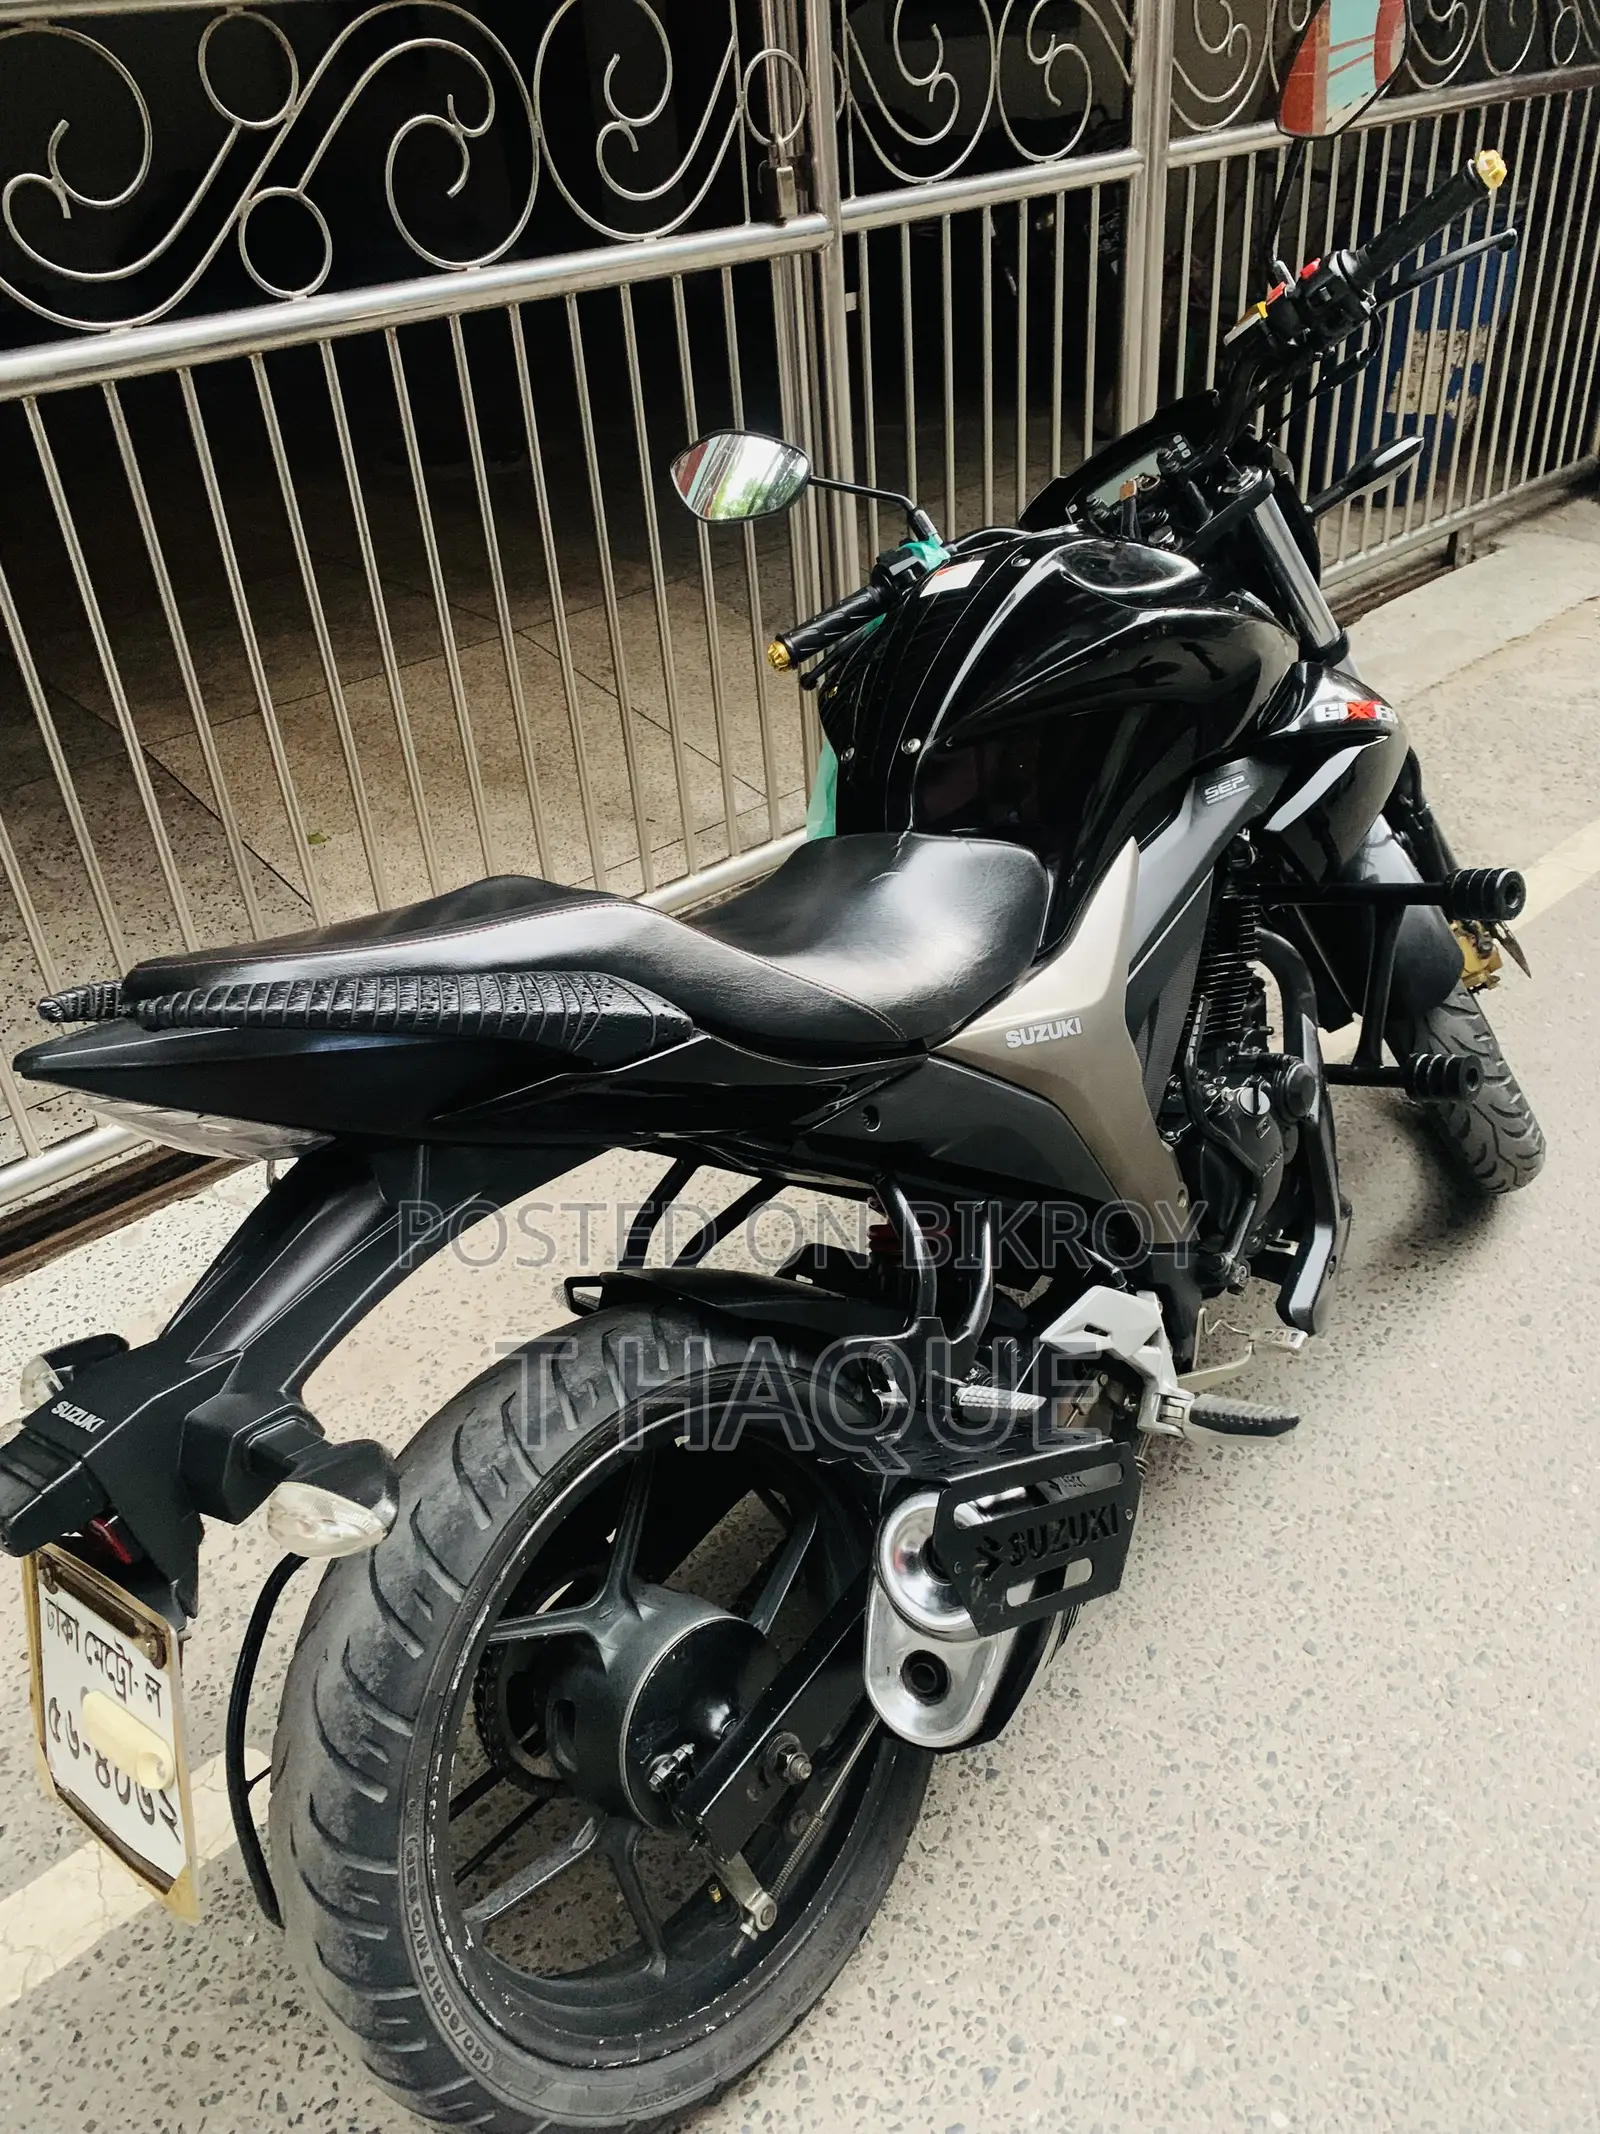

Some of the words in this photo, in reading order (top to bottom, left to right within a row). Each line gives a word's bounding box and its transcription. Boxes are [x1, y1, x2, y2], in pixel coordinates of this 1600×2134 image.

[1005, 1017, 1083, 1049] SUZUKI
[50, 1400, 106, 1433] SUZUKI
[1007, 1502, 1120, 1567] SUZUKI
[44, 1597, 80, 1654] ঢাকা
